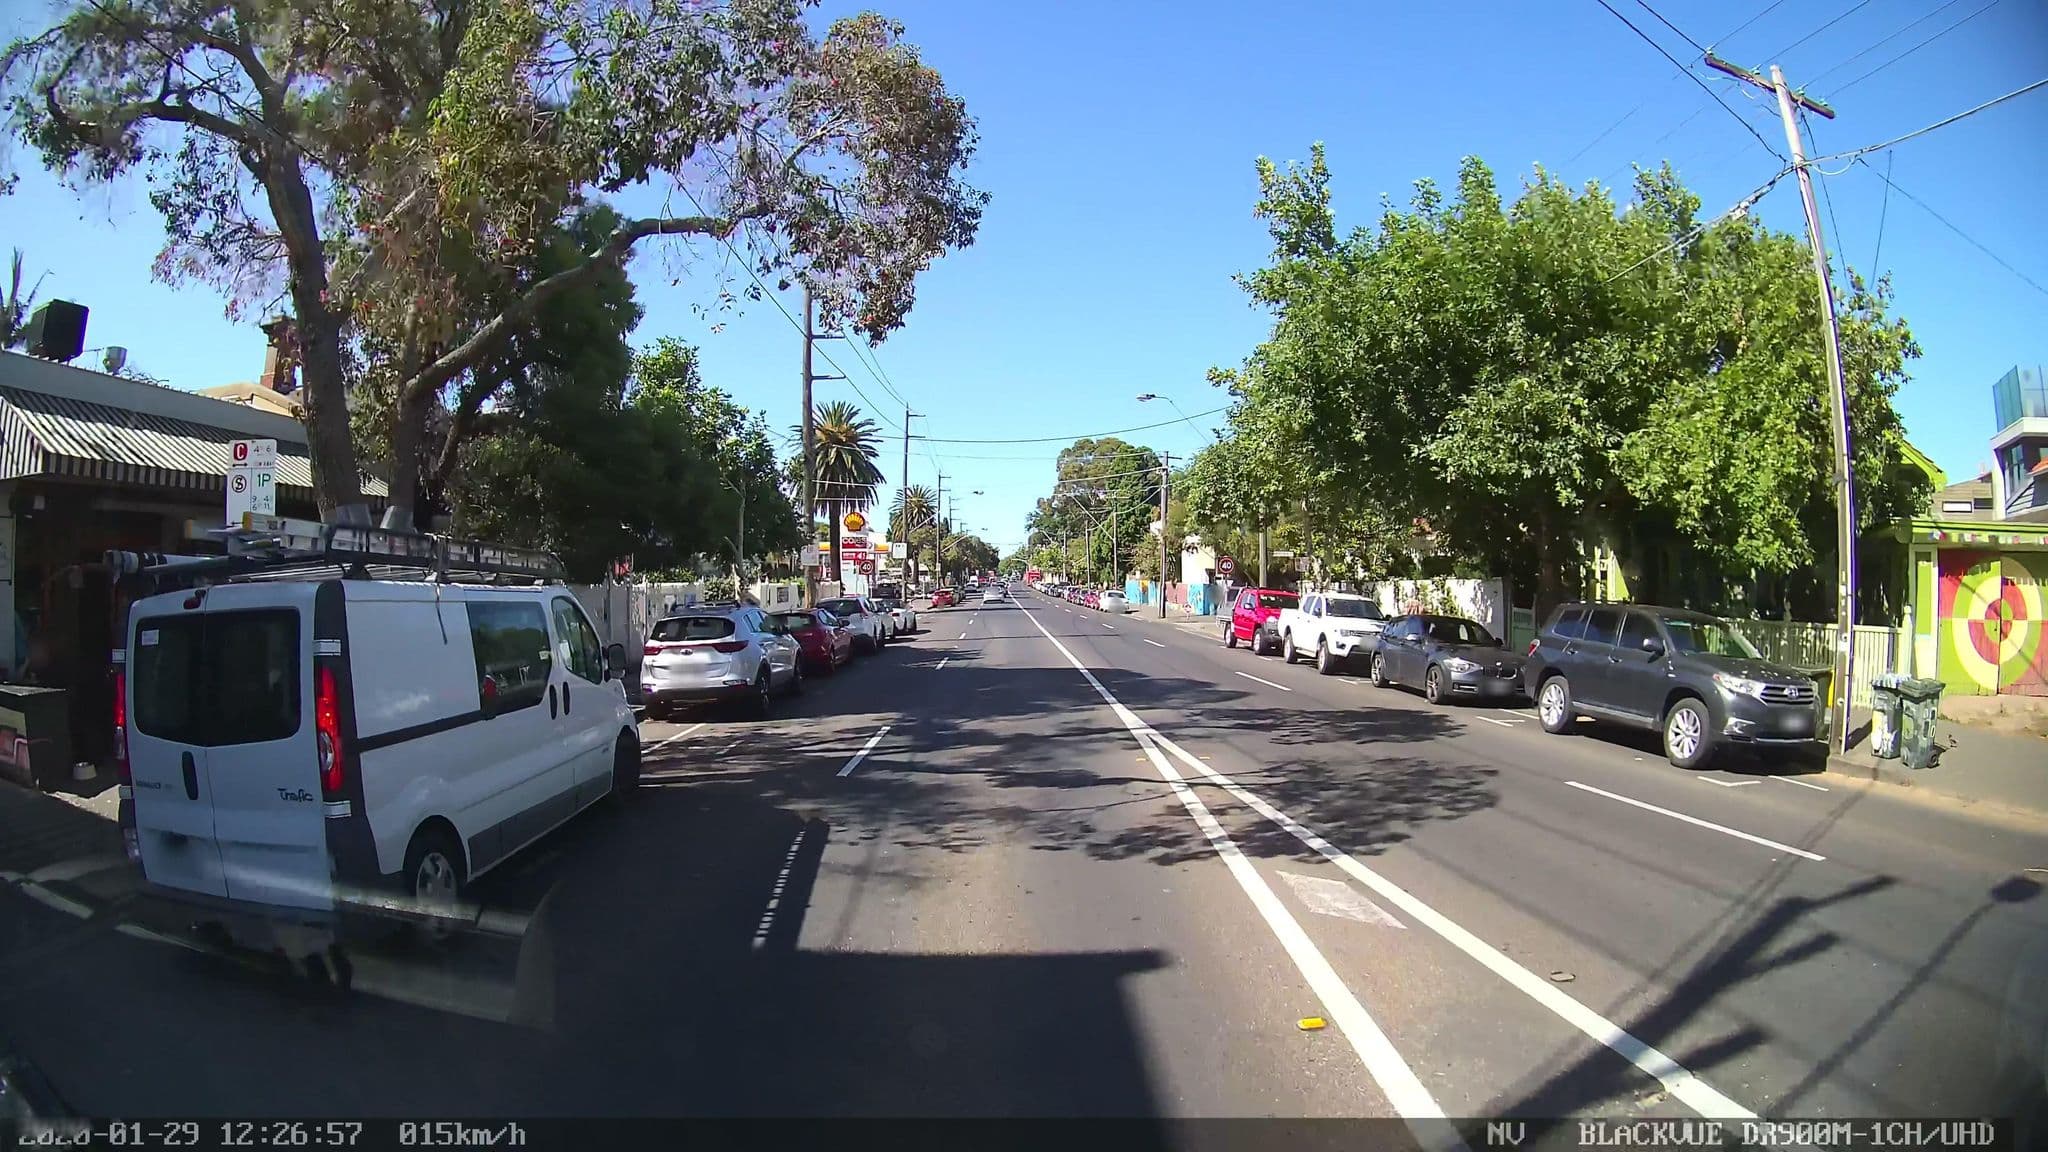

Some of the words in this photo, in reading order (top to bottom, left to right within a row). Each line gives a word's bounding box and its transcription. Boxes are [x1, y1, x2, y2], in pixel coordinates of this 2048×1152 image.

[257, 473, 271, 487] 1P
[862, 563, 872, 571] 40
[1221, 561, 1232, 570] 40
[277, 788, 313, 803] Trafic
